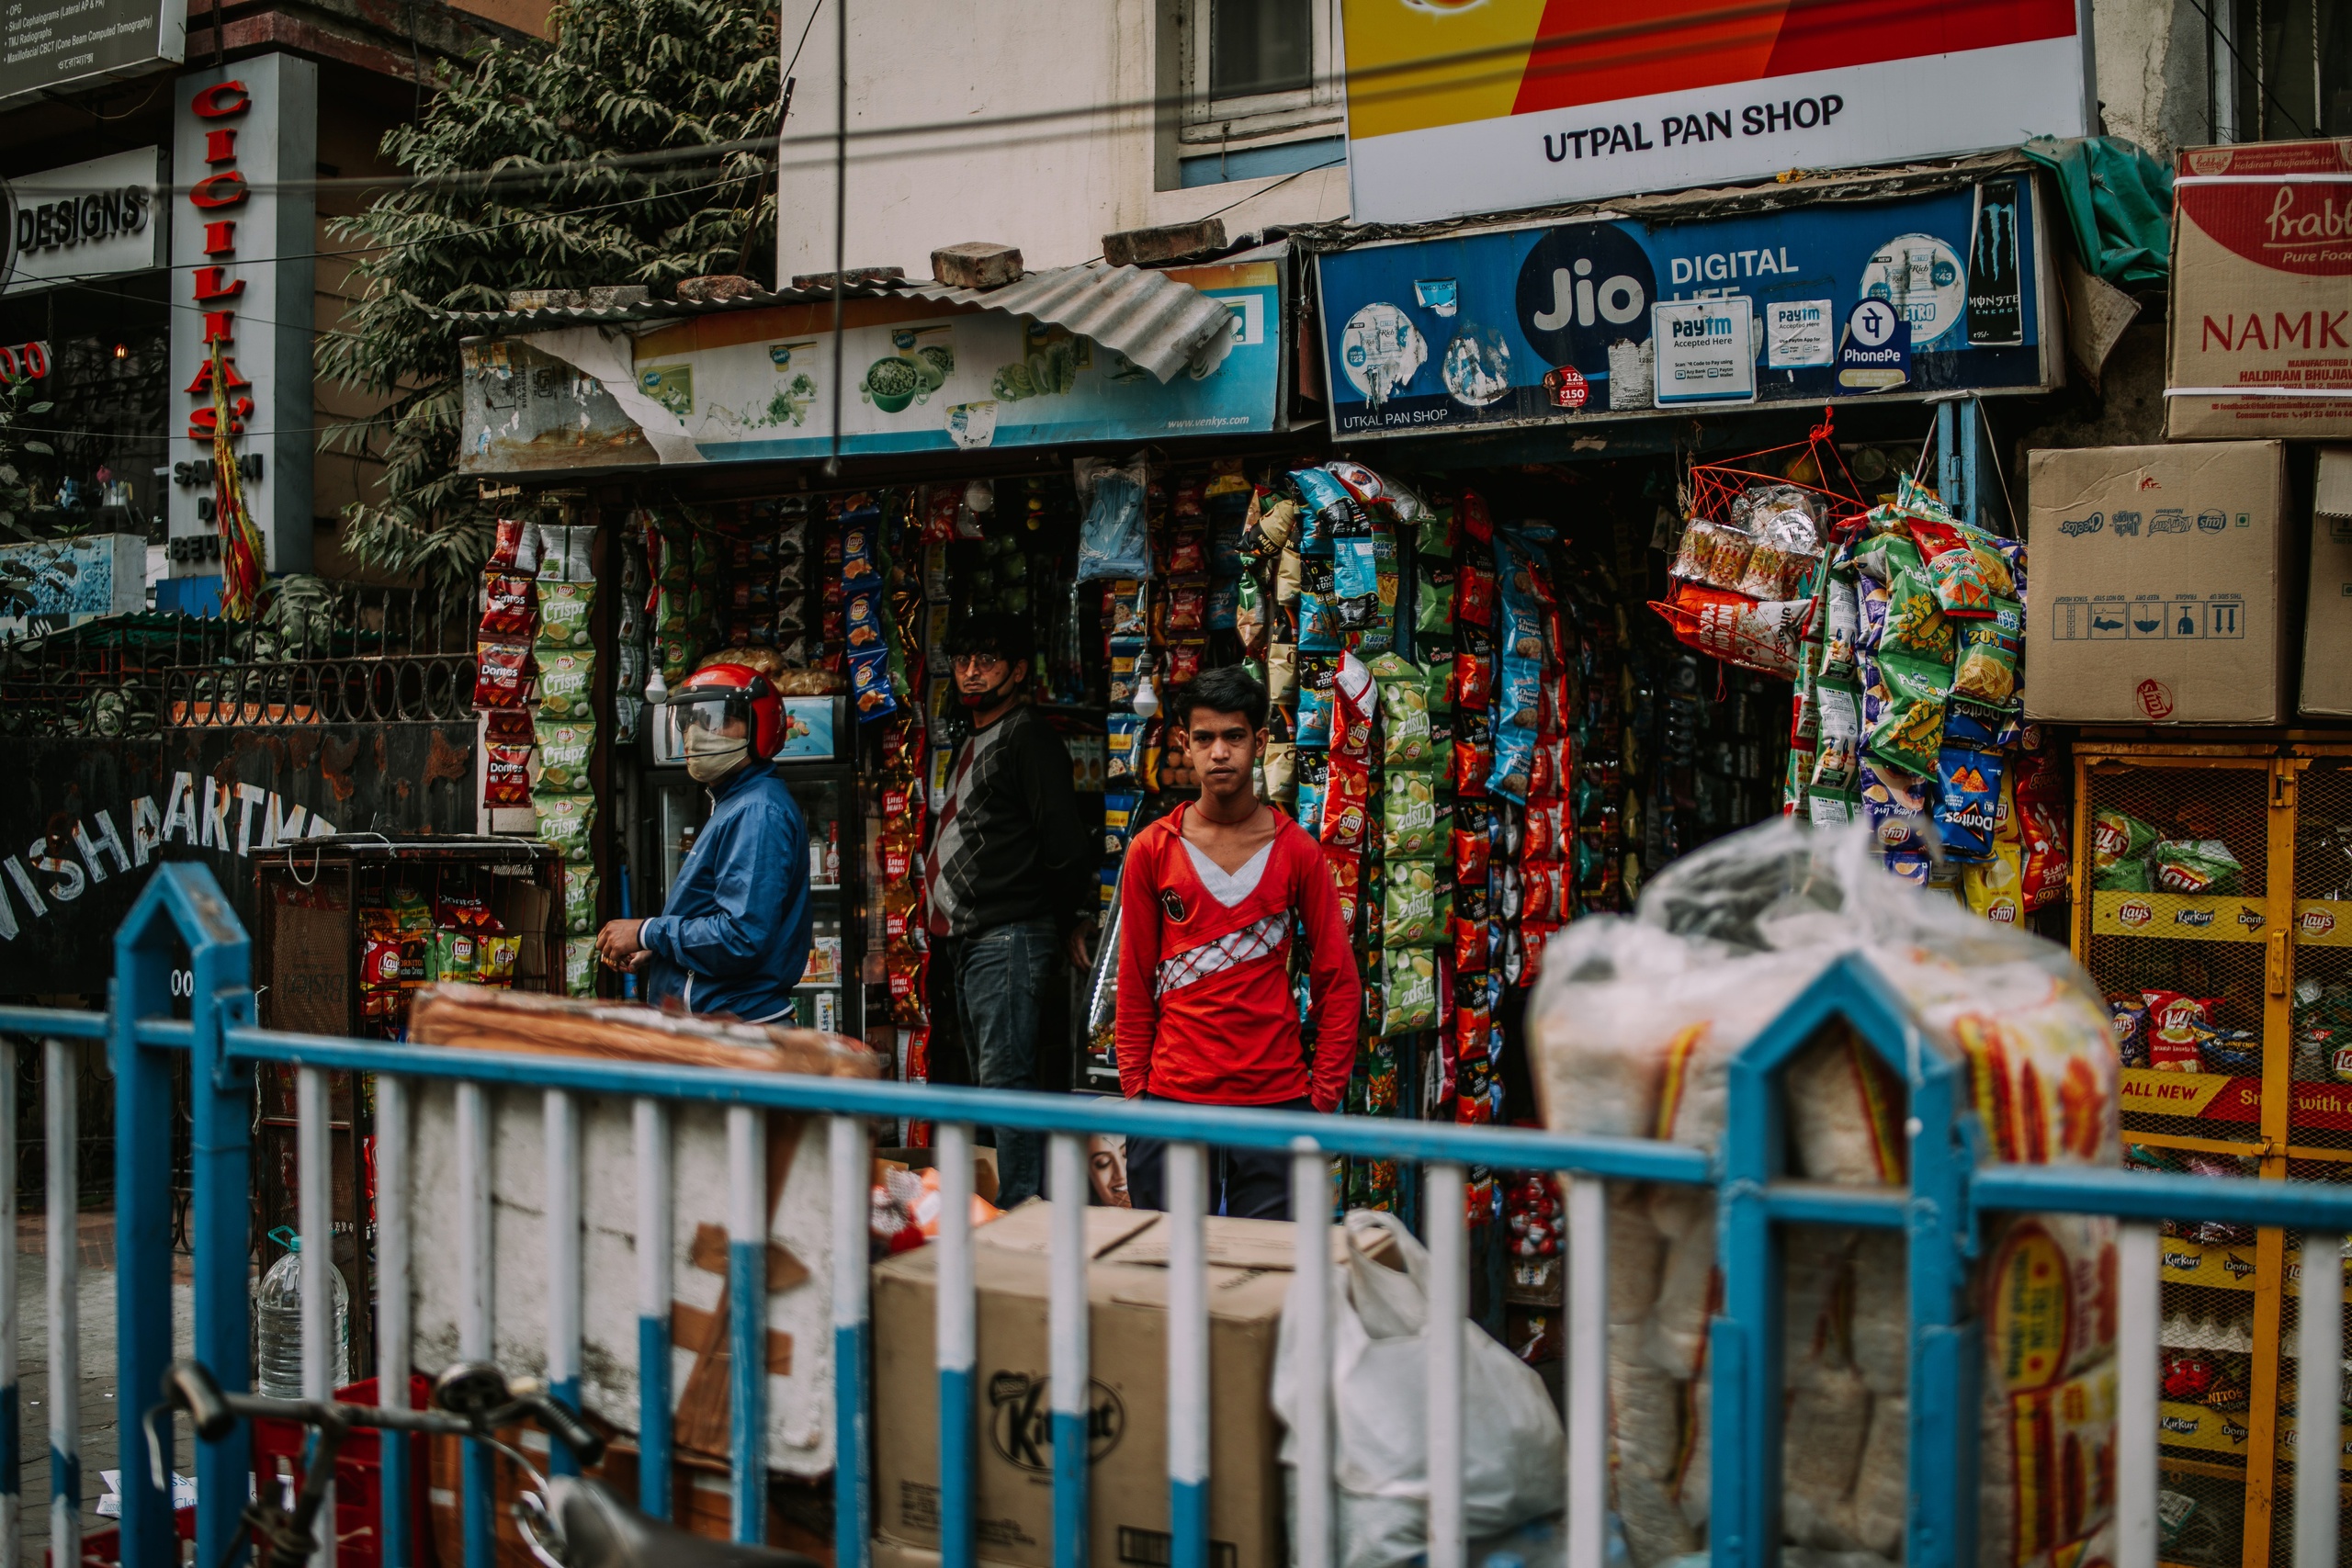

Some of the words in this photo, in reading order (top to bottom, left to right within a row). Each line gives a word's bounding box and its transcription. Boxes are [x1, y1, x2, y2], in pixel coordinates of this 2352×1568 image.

[9, 3, 22, 17] OPG
[9, 19, 22, 31] Skull
[23, 9, 60, 28] Cephalograms
[61, 3, 80, 19] (Lateral
[7, 50, 39, 64] Maxillofacial
[40, 41, 54, 55] CBCT
[55, 39, 72, 52] (Cone
[72, 35, 87, 45] Beam
[87, 24, 116, 41] Computed
[117, 15, 153, 34] Tomography)
[8, 37, 18, 48] TMJ
[19, 28, 52, 44] Radiographs
[1543, 119, 1653, 164] UTPAL
[1659, 107, 1734, 149] PAN
[1742, 93, 1845, 137] SHOP
[2233, 152, 2265, 161] Exclusively
[2265, 151, 2303, 159] manufactured
[2233, 160, 2272, 170] Haldiram
[2273, 157, 2321, 168] Bhujiawala
[2322, 156, 2337, 164] Ltd.
[17, 185, 145, 252] DESIGNS
[1670, 246, 1799, 285] DIGITAL
[2282, 251, 2317, 264] Pure
[1533, 258, 1645, 331] Jio
[1861, 308, 1883, 339] पे
[2201, 310, 2350, 354] NAMK
[1674, 338, 1711, 348] Accepted
[1713, 337, 1733, 345] Here
[1844, 348, 1901, 363] PhonePe
[2288, 359, 2349, 368] MANUFACTURED
[2240, 369, 2301, 382] HALDIRAM
[2220, 401, 2327, 410] feedback@haldiramlimited.com
[1168, 414, 1250, 430] www.venkys.com
[1344, 412, 1384, 429] UTKAL
[1385, 411, 1411, 425] PAN
[1413, 409, 1448, 422] SHOP
[2061, 513, 2104, 536] Cheetos
[2111, 512, 2142, 526] Chipps
[2149, 514, 2192, 533] Kurkure
[2114, 523, 2138, 536] Uncle
[543, 602, 587, 623] Crispz
[1969, 629, 2000, 649] 20%
[481, 664, 519, 677] Doritos
[543, 672, 587, 694] Crispz
[1953, 702, 2000, 722] Doritos
[543, 746, 587, 767] Crispz
[490, 762, 524, 773] Doritos
[1396, 802, 1433, 833] Crispz
[1893, 806, 1917, 818] Cheesy
[1944, 811, 1994, 832] Doritos
[540, 818, 584, 840] Crispz
[2095, 825, 2127, 855] ay's
[2176, 909, 2215, 923] Kurkure
[2239, 913, 2267, 925] Dorit
[1401, 977, 1433, 1008] rispz
[2121, 1080, 2154, 1098] ALL
[2156, 1084, 2199, 1101] NEW
[2299, 1095, 2342, 1113] with
[2165, 1254, 2201, 1266] Kurkure
[2162, 1416, 2199, 1429] Kurkure
[2223, 1426, 2249, 1437] Dorit
